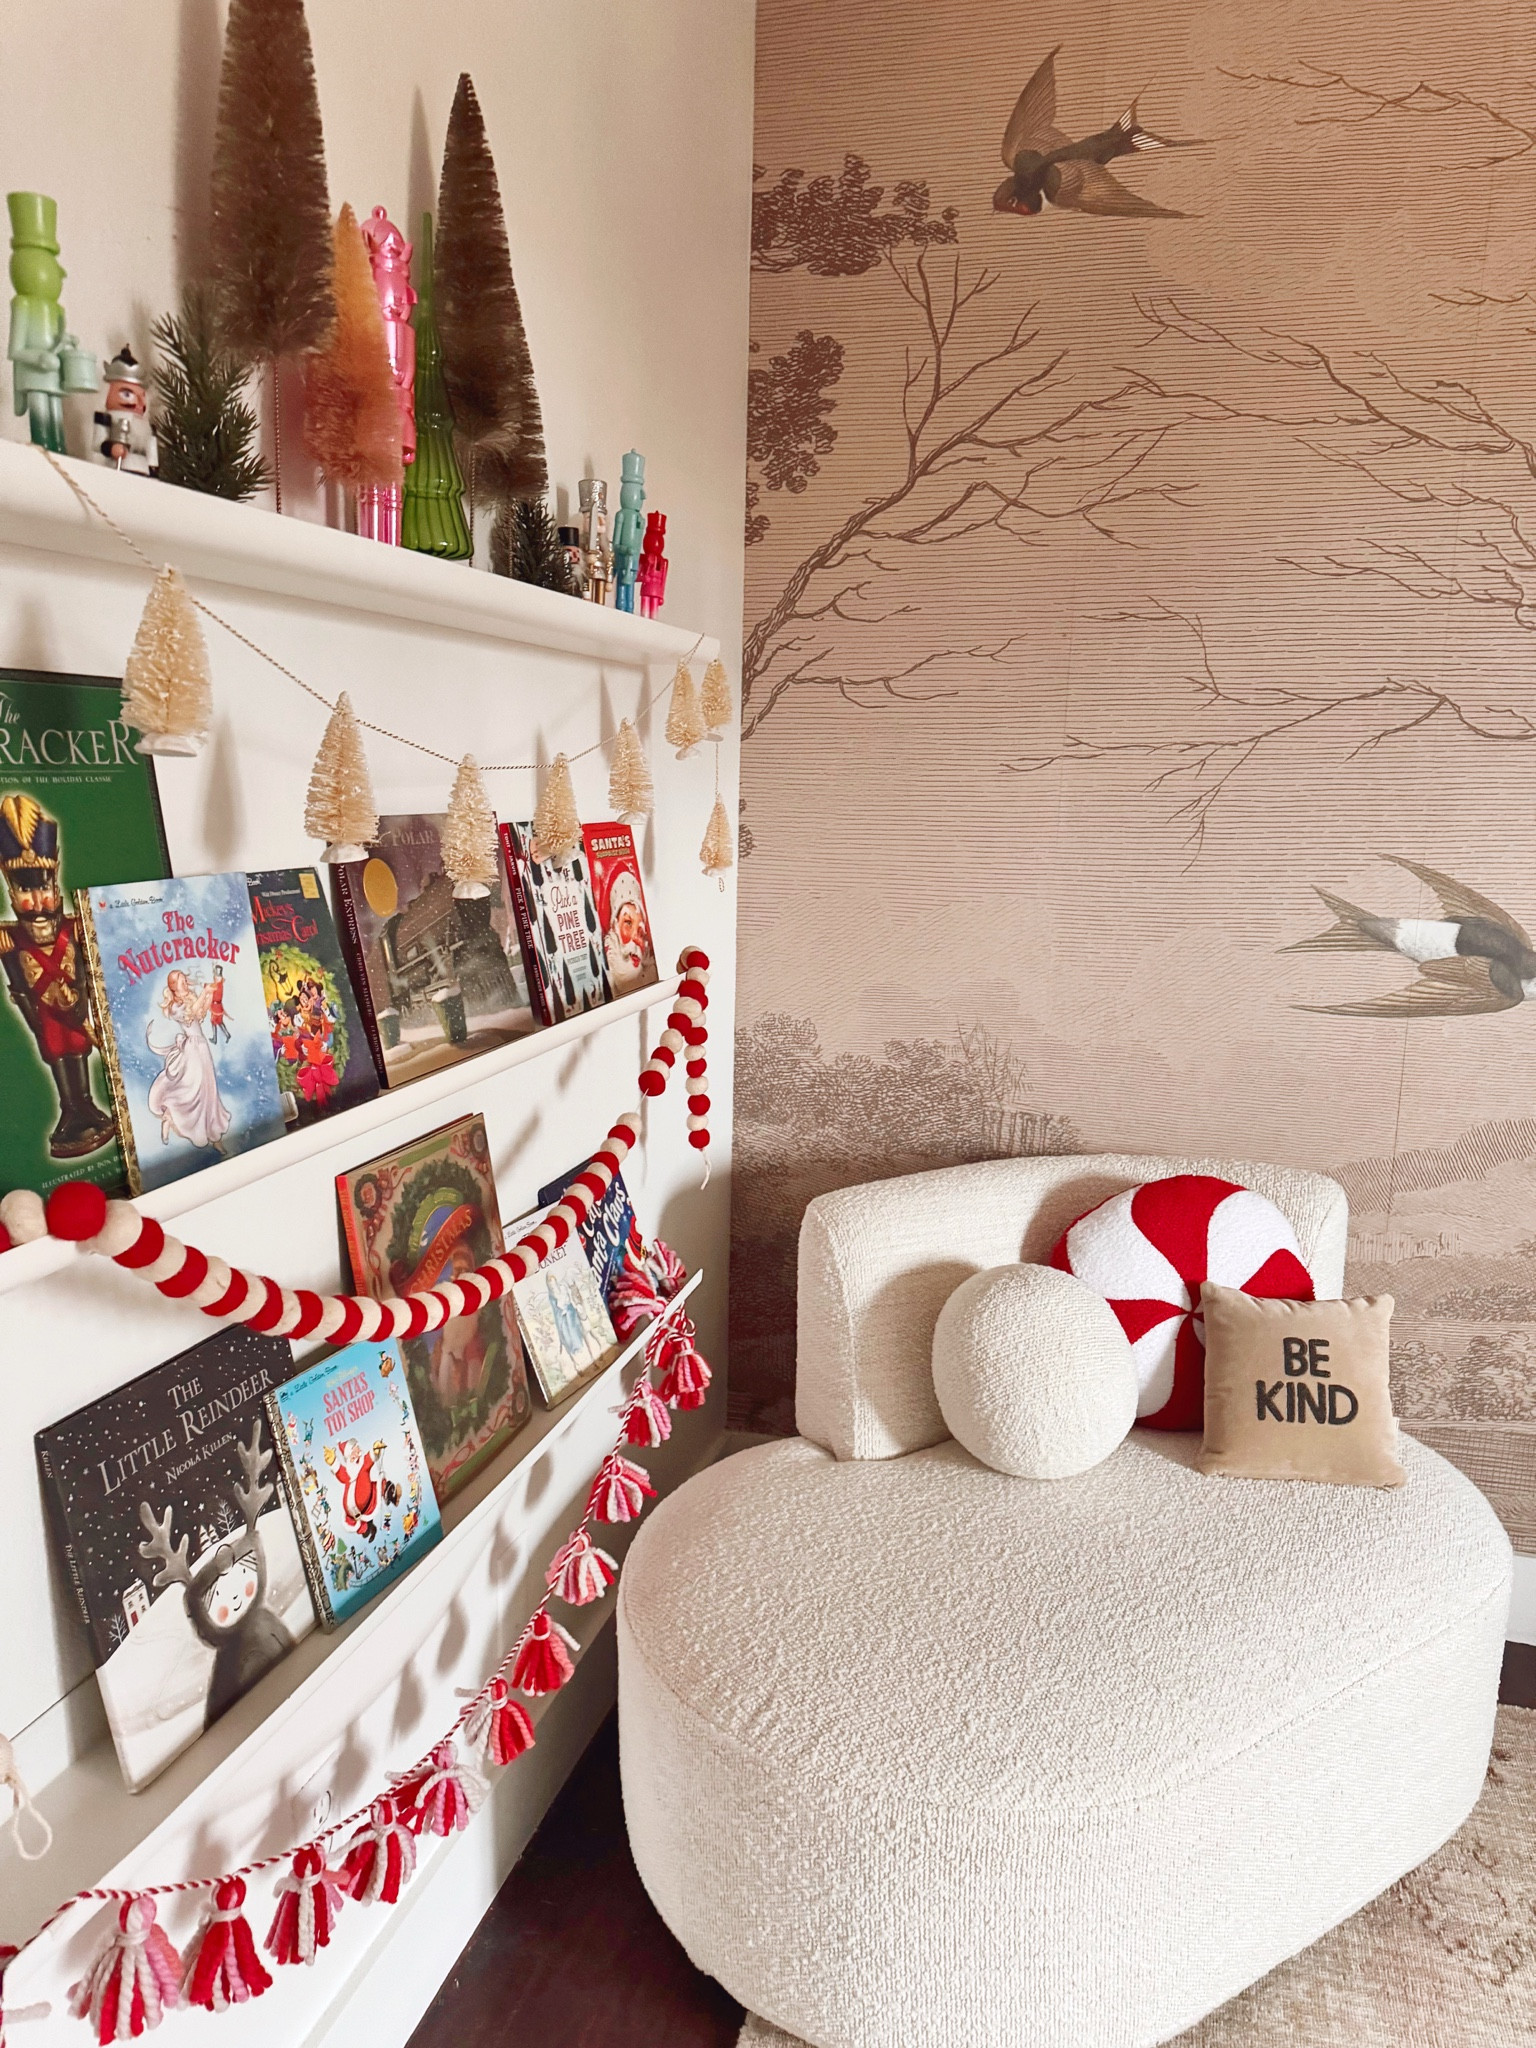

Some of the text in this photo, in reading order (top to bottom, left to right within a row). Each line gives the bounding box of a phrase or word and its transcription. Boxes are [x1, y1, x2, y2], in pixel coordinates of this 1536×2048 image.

[0, 720, 139, 765] RACKER
[391, 829, 435, 848] POLAR
[591, 835, 631, 852] SANTA'S
[130, 898, 149, 908] Golden
[551, 886, 578, 913] Pick a
[162, 910, 195, 935] The
[291, 915, 319, 943] Carol
[343, 898, 357, 944] EXPRESS
[515, 887, 524, 904] PICK
[521, 912, 529, 930] PINE
[525, 930, 534, 950] TREE
[557, 910, 580, 932] PINE
[117, 928, 241, 987] Nutcracker
[558, 929, 587, 954] TREE
[582, 1198, 604, 1238] Cat
[592, 1231, 609, 1284] anta
[603, 1182, 626, 1247] Claus
[536, 1240, 568, 1274] ONKEY
[1283, 1337, 1331, 1378] BE
[167, 1377, 203, 1410] THE
[309, 1372, 326, 1385] Golden
[324, 1390, 375, 1437] TOY SHOP
[1256, 1379, 1359, 1426] KIND
[97, 1368, 274, 1497] LITTLE REINDEER
[165, 1432, 233, 1485] NICOLA KILLEN
